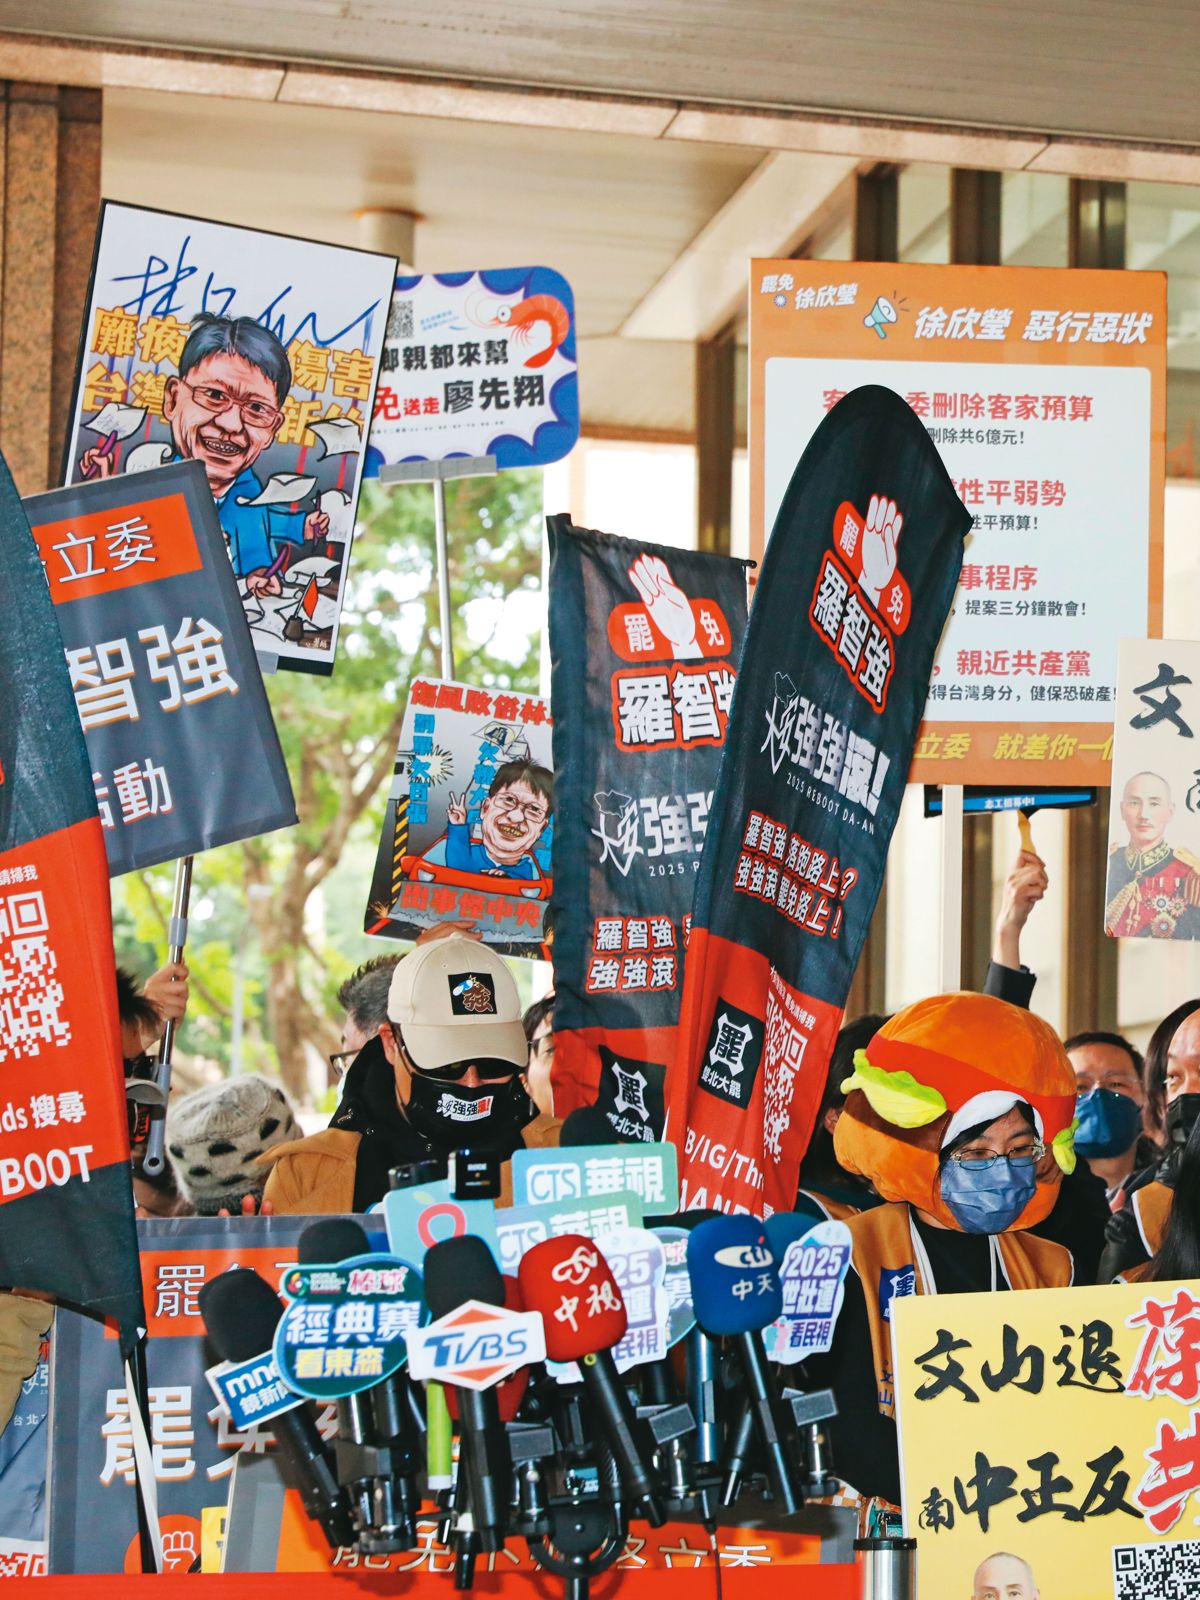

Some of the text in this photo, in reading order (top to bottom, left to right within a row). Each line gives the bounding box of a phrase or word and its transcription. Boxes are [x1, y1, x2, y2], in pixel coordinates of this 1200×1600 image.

[760, 273, 859, 310] 罷免 徐欣瑩
[914, 306, 1153, 345] 徐欣瑩 惡行惡狀
[285, 338, 376, 402] 傷害
[948, 478, 1067, 507] 性平弱勢
[36, 515, 157, 587] 立委
[839, 513, 905, 626] 罷 免
[958, 564, 1039, 592] 事程序
[623, 608, 725, 653] 罷 免
[813, 559, 892, 704] 羅智強
[66, 616, 240, 731] 智強
[410, 680, 552, 726] 傷風敗俗林
[914, 733, 971, 761] 立委
[786, 771, 806, 793] 2025
[806, 788, 839, 817] REBOOT
[649, 863, 686, 877] 2025
[596, 918, 675, 952] 羅智強
[588, 958, 674, 991] 強強滾
[30, 1090, 87, 1130] 搜尋
[0, 1145, 94, 1196] BOOT
[684, 1126, 764, 1192] B/IG/Thr
[585, 1155, 666, 1204] 華視
[610, 1250, 652, 1288] 25
[784, 1245, 844, 1279] 2025
[553, 1280, 622, 1333] 中視
[731, 1273, 775, 1301] 中天
[285, 1300, 421, 1345] 經典賽
[789, 1320, 832, 1348] 看民視
[293, 1346, 385, 1378] 看東森
[424, 1328, 528, 1367] TVBS
[614, 1326, 660, 1361] 民視
